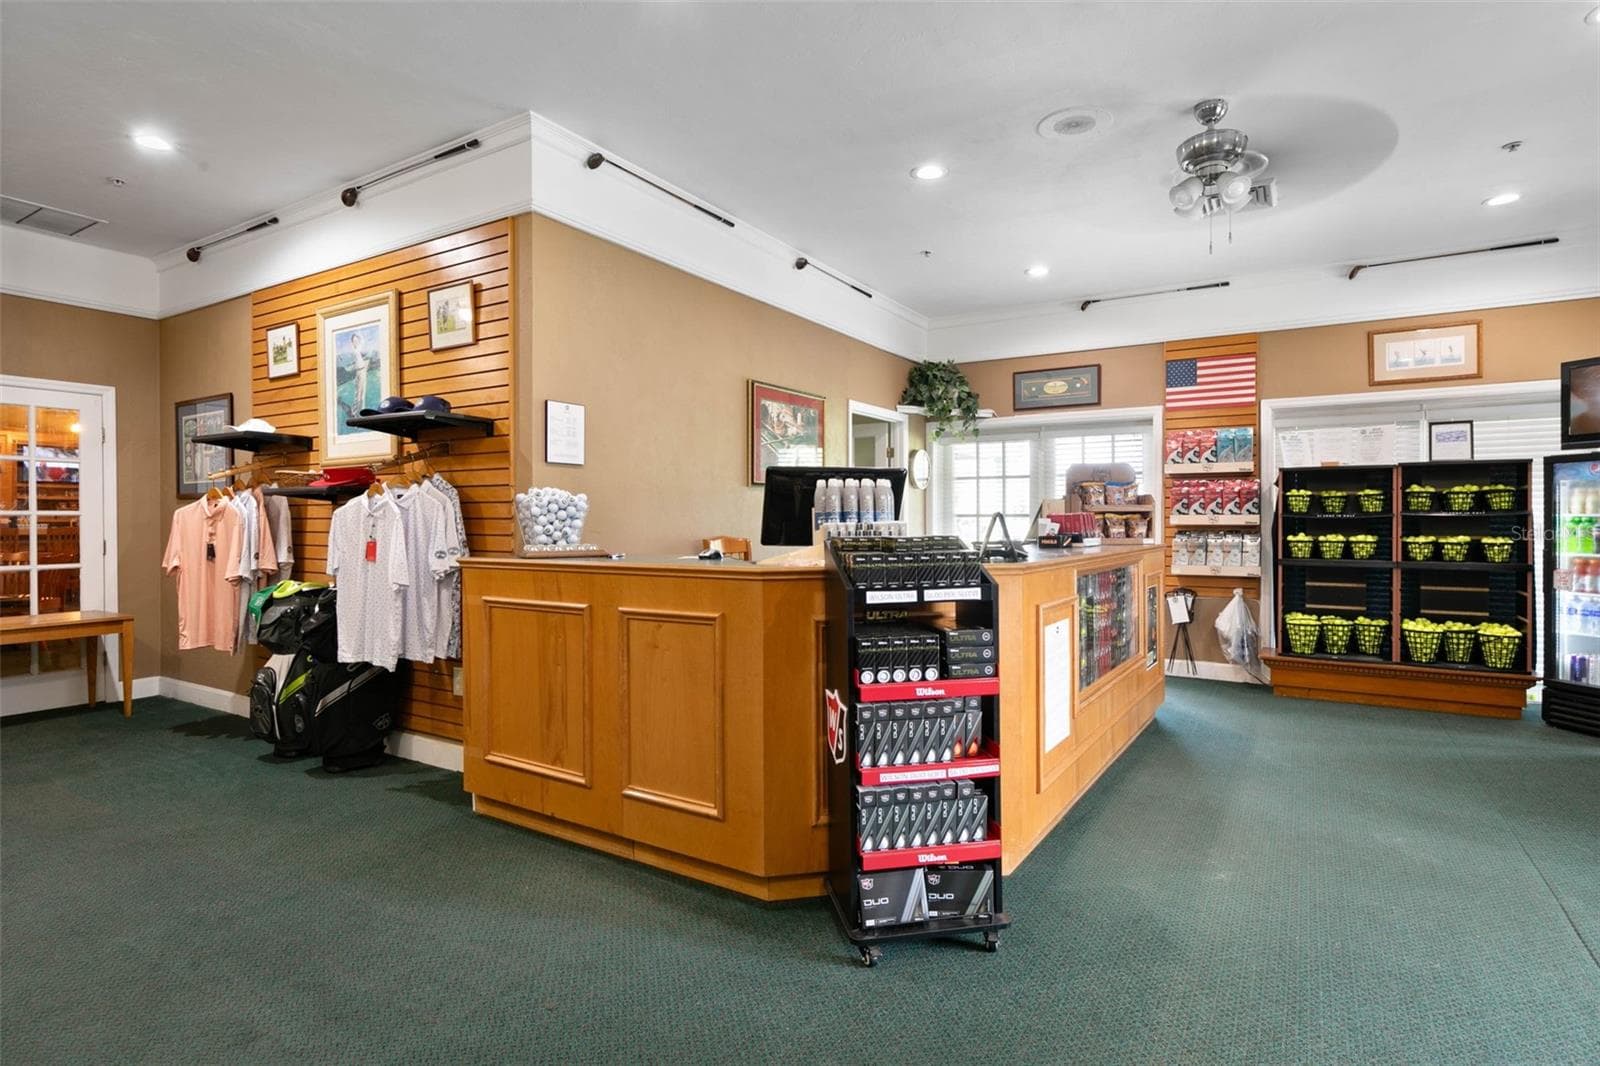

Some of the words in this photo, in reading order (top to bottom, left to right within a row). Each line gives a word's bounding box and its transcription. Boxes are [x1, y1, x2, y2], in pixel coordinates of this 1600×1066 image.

[866, 610, 909, 620] ULTRA
[949, 634, 977, 642] ULTRA
[951, 651, 978, 659] ULTRA
[952, 668, 980, 676] ULTRA
[915, 688, 945, 696] Wilson
[918, 853, 947, 863] Wilson
[863, 897, 889, 907] DUO
